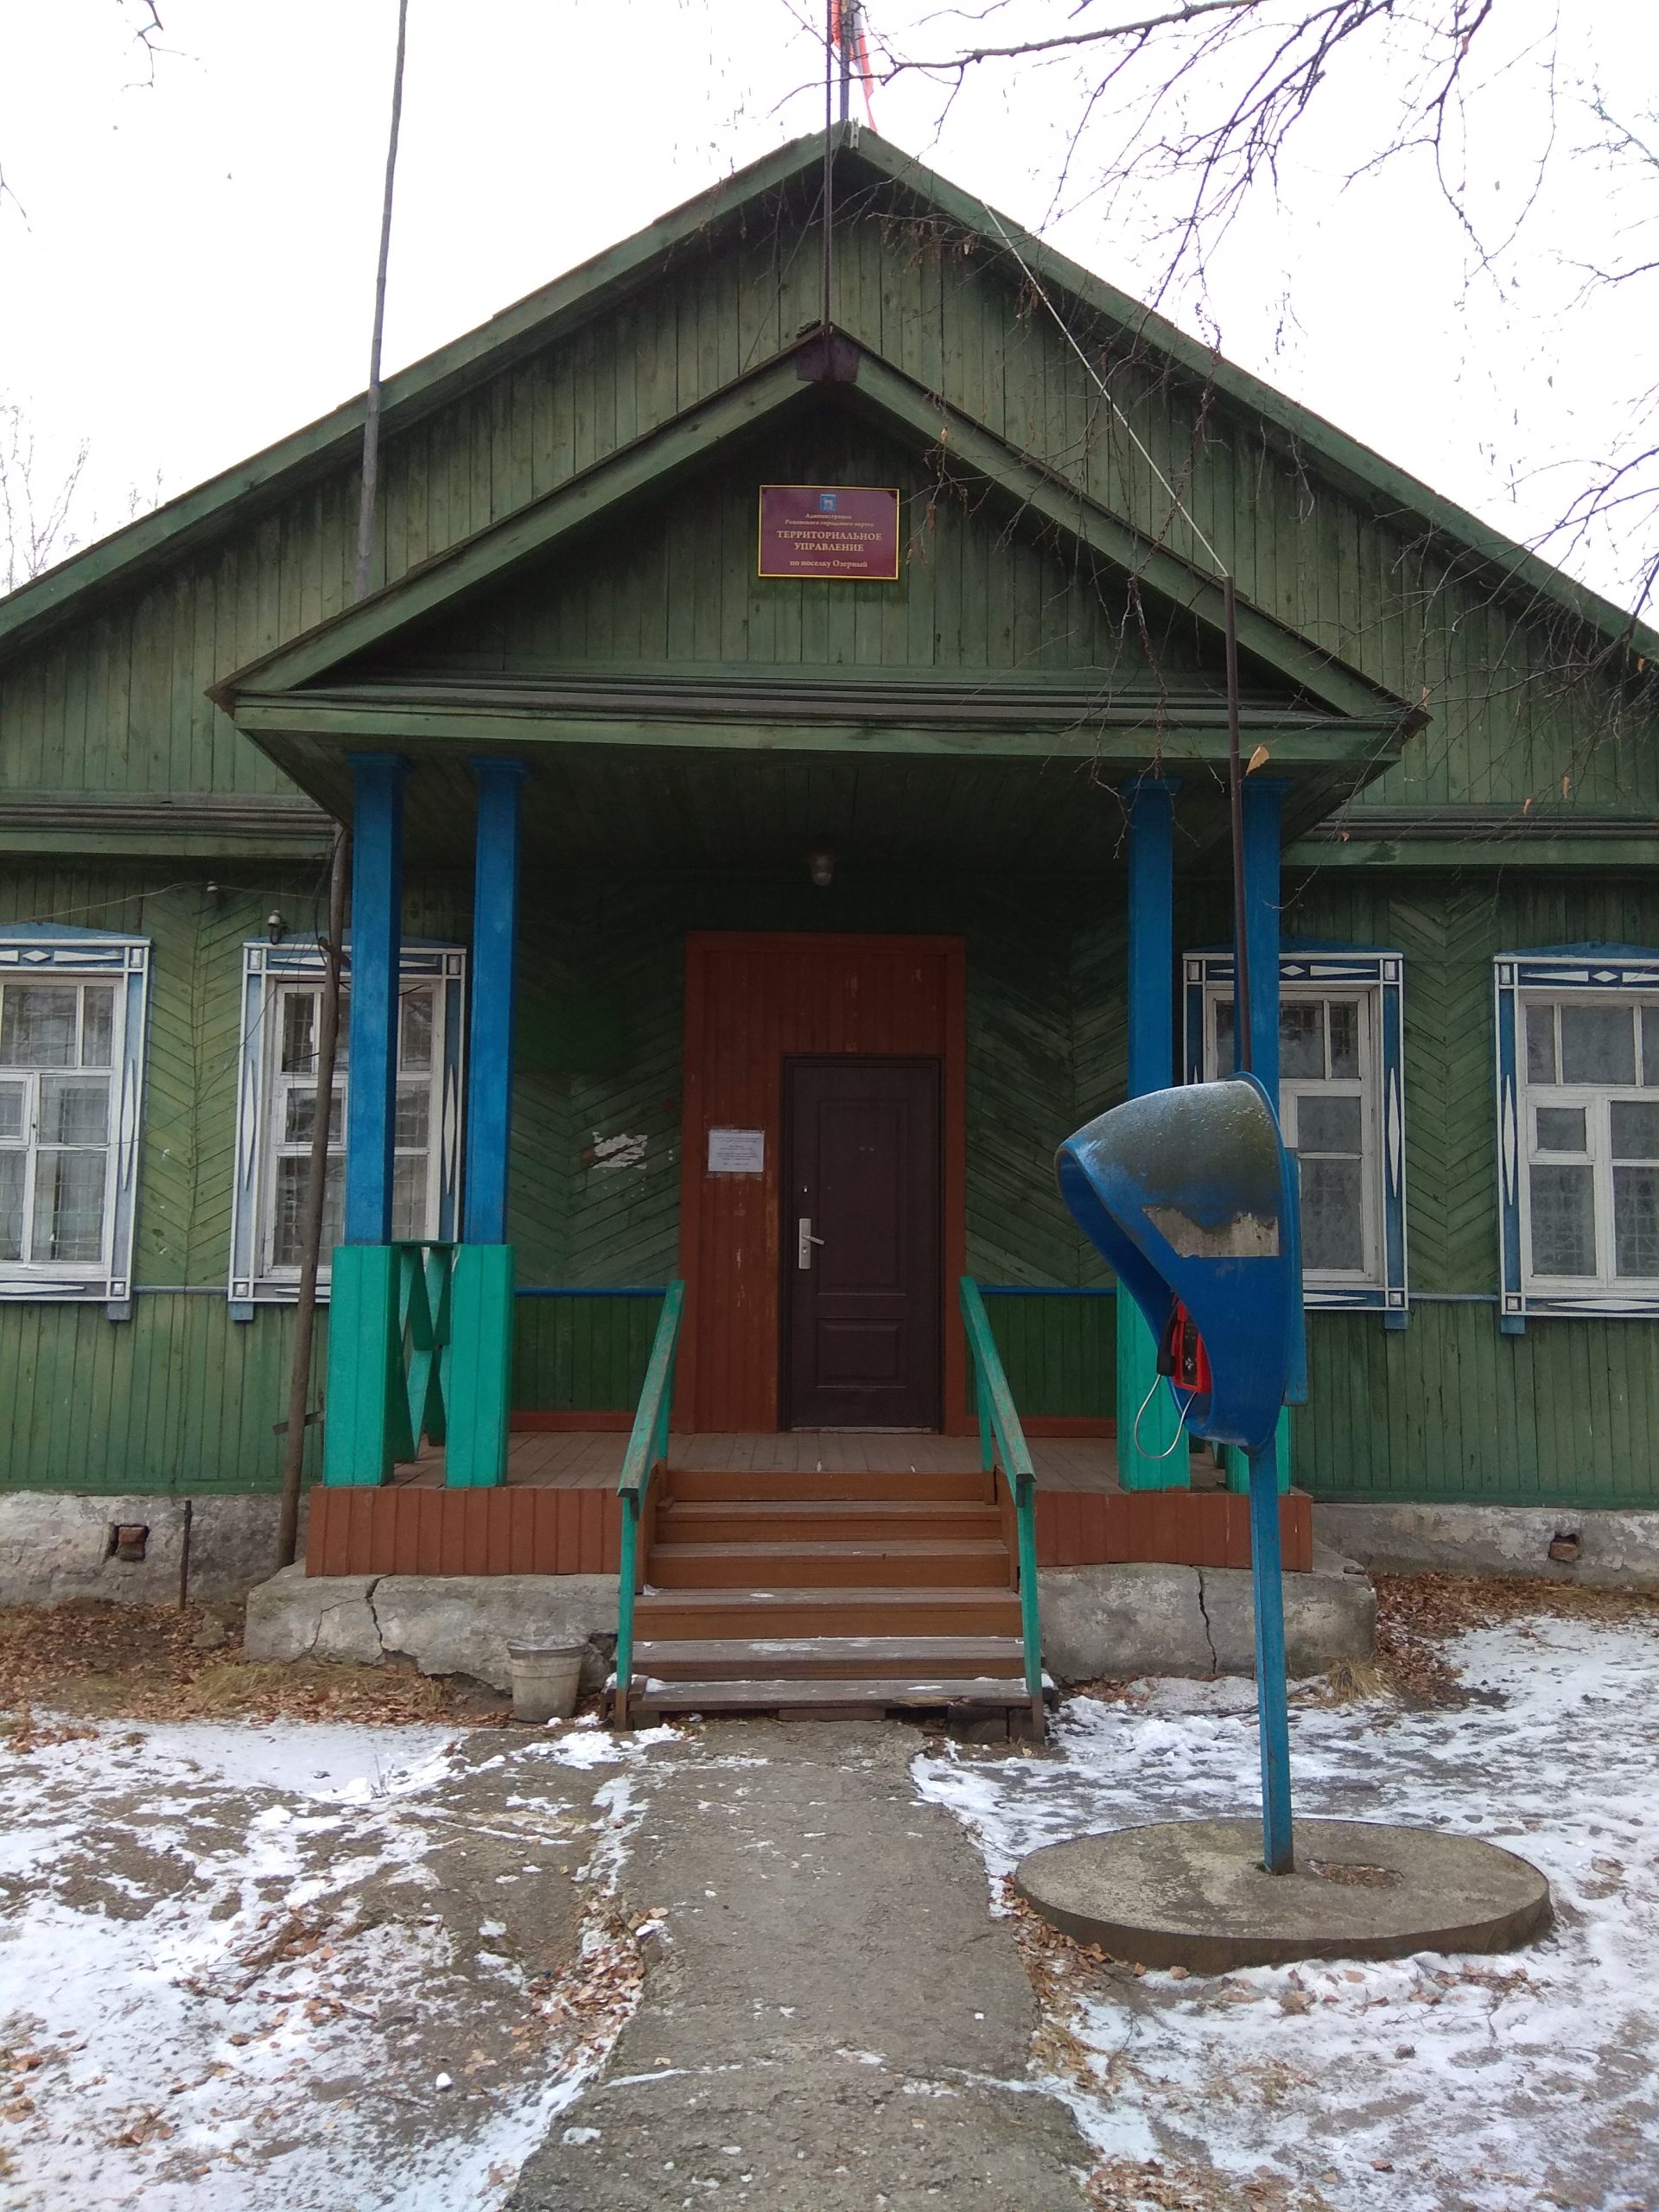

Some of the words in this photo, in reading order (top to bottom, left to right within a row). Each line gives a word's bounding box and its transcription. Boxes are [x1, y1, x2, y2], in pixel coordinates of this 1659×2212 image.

[777, 531, 882, 541] ТЕРРИТОРИАЛЬНОЕ
[794, 543, 864, 551] УПРАВЛЕНИЕ
[832, 560, 868, 569] Озерный
